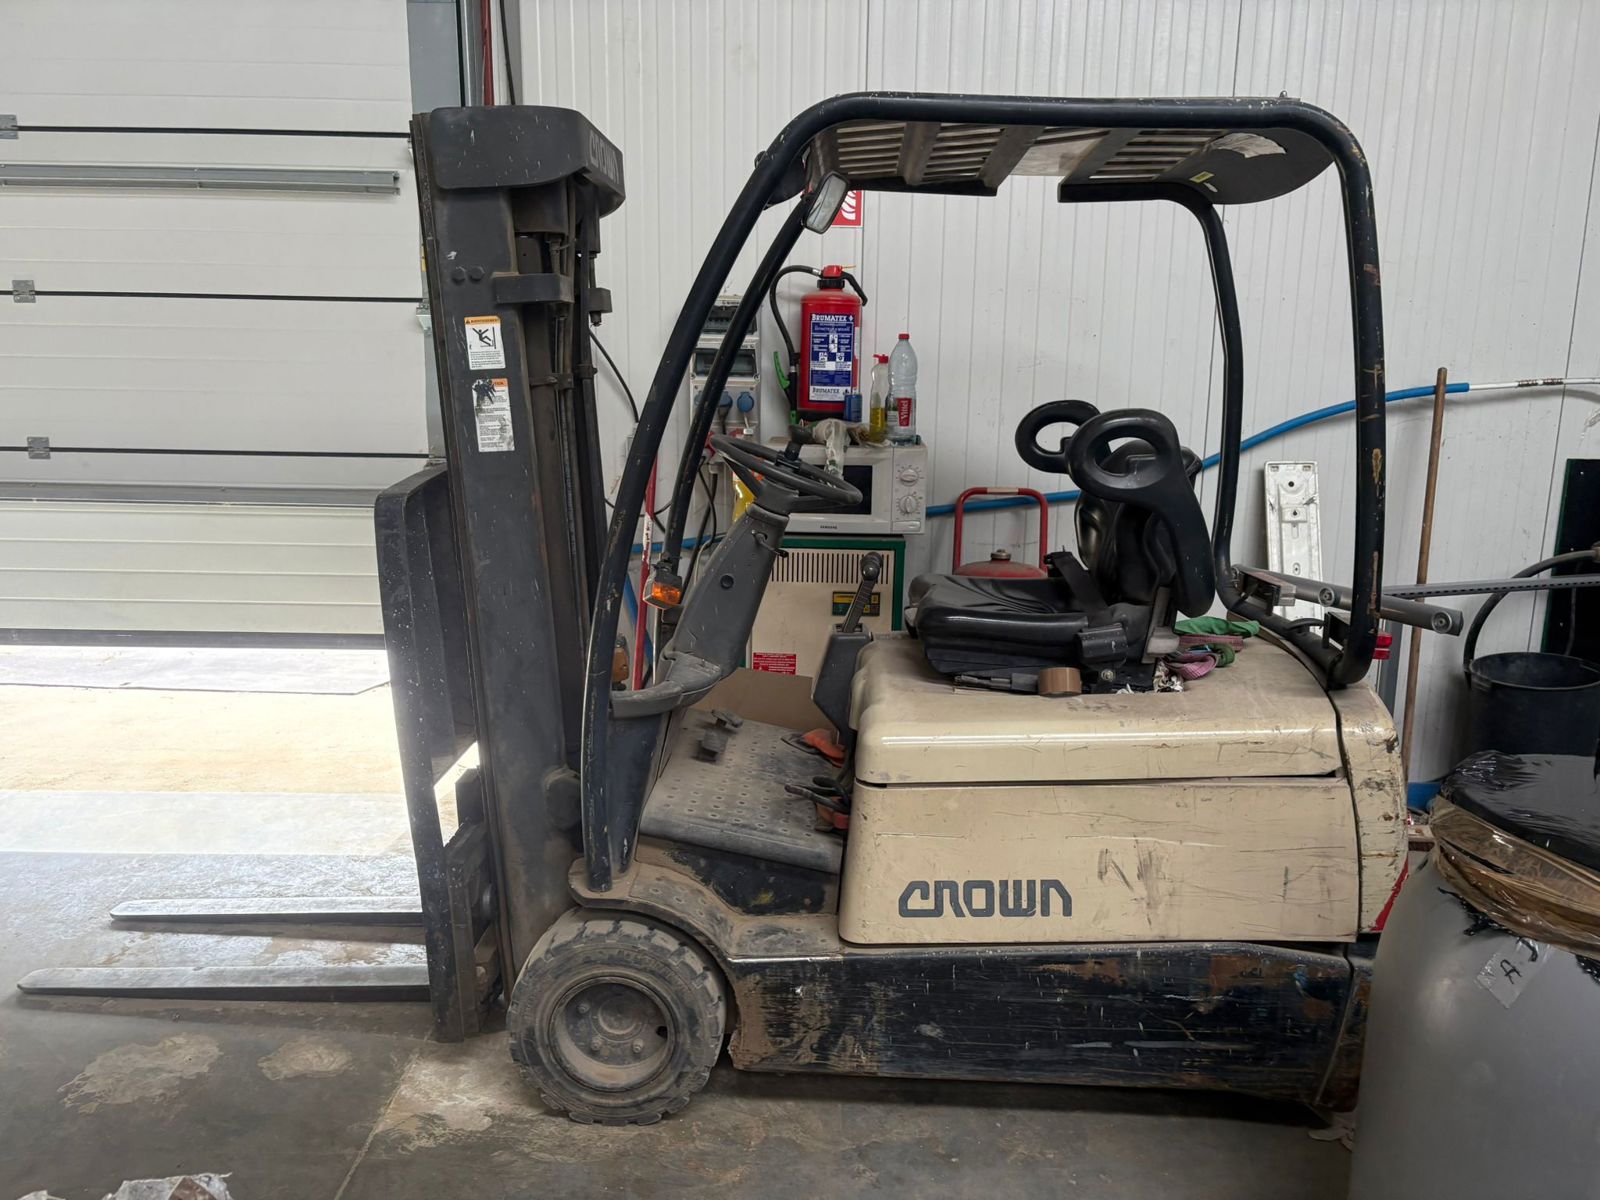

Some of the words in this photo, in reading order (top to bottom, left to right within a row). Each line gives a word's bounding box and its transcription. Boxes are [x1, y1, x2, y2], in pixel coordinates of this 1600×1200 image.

[589, 129, 620, 185] CROWN
[811, 314, 848, 322] BRUMATEX
[898, 879, 1072, 918] CROWN
